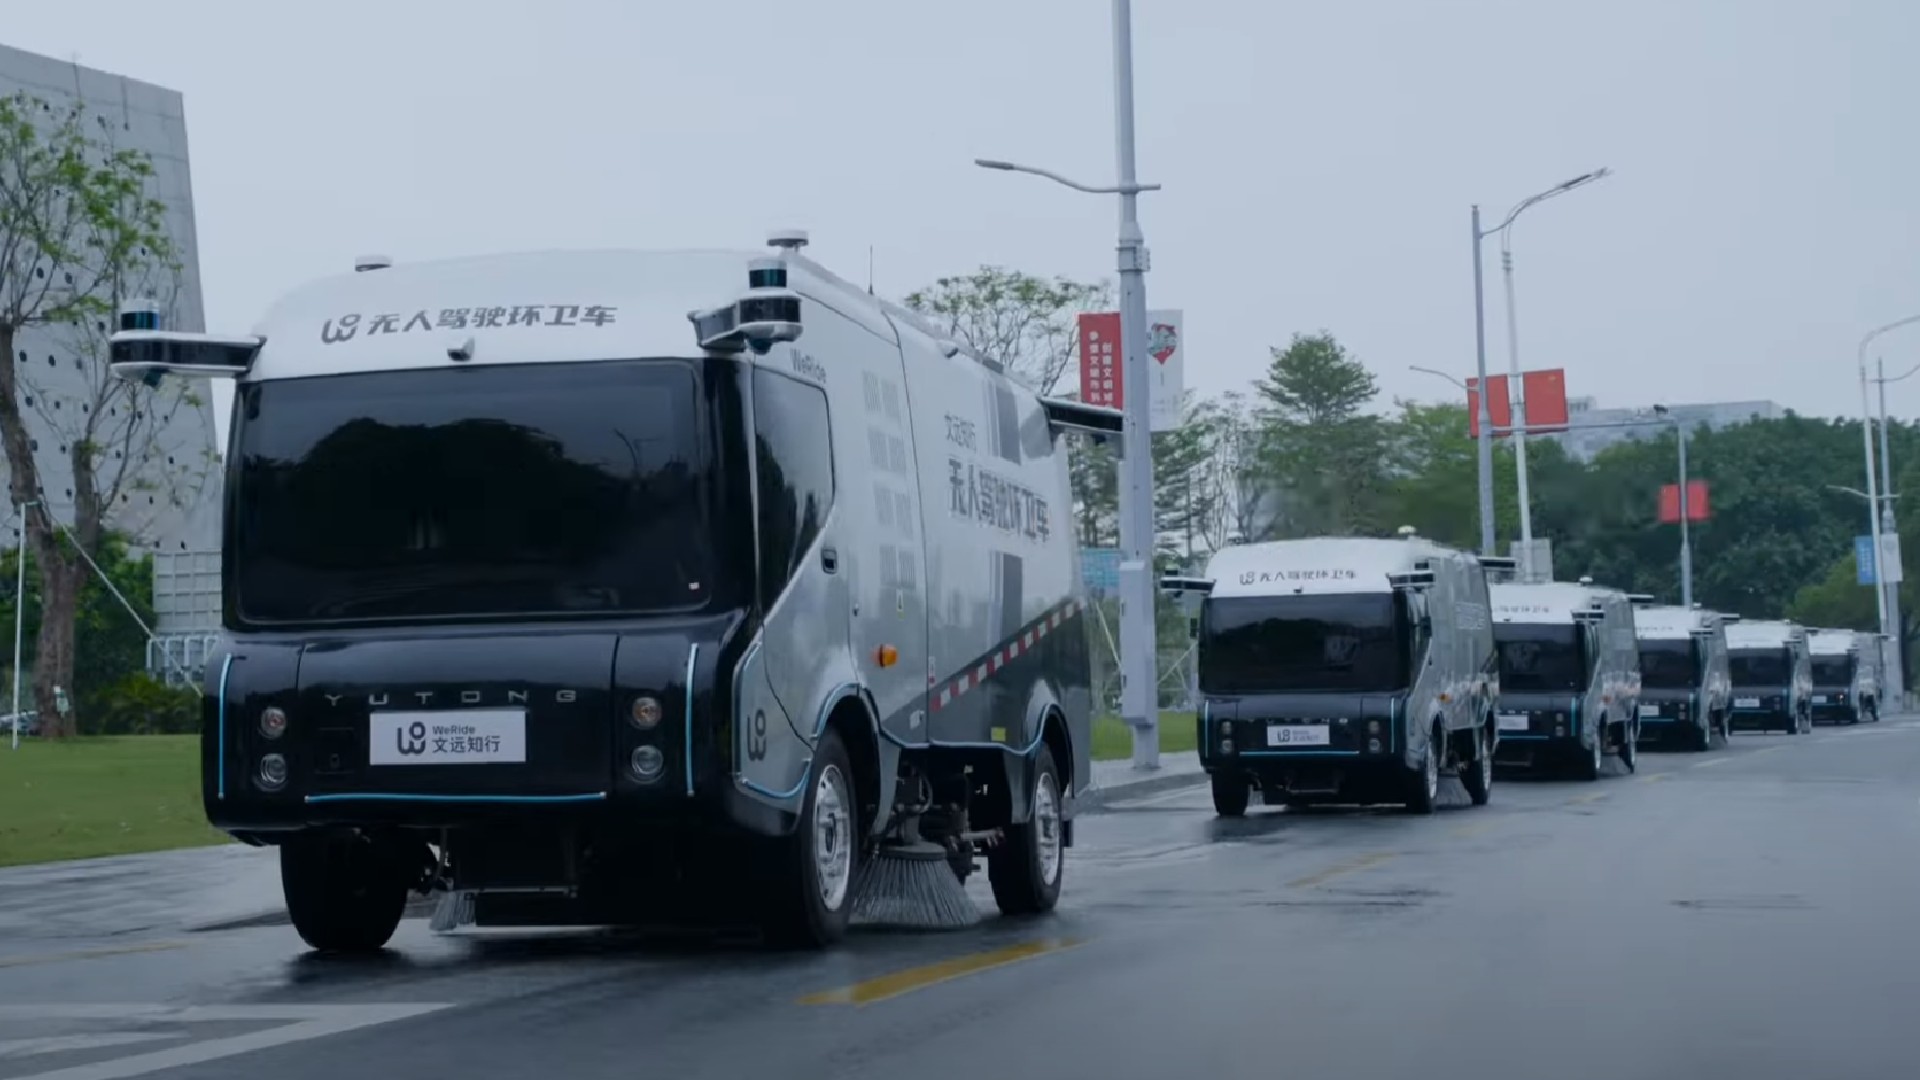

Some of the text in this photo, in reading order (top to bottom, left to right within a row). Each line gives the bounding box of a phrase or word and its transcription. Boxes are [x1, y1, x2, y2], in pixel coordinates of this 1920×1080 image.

[367, 304, 618, 336] 无人驾驶环卫车
[324, 690, 577, 706] YUTONG
[432, 725, 476, 735] WeRide
[432, 735, 501, 753] 文远知行
